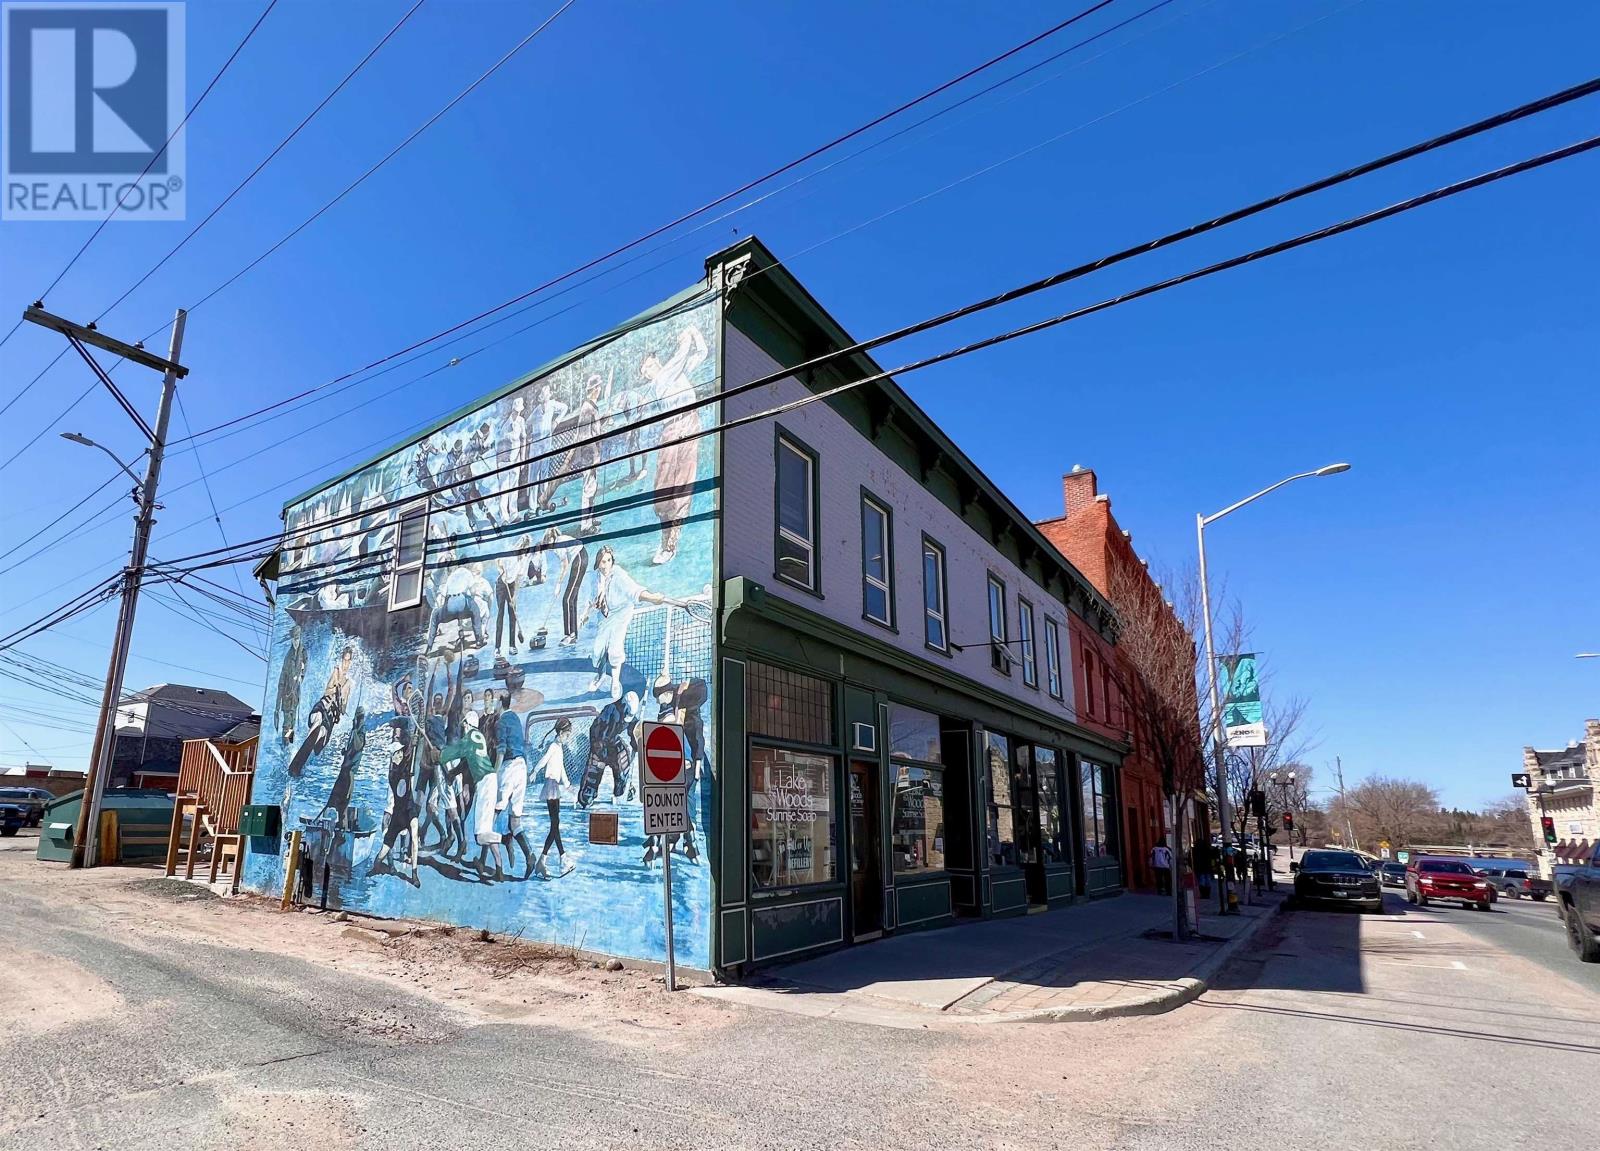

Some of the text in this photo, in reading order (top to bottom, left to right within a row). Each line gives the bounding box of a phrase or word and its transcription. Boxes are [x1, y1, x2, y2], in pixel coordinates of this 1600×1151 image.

[779, 763, 807, 790] Lake
[776, 787, 813, 808] Woods
[650, 812, 683, 827] ENTER
[797, 808, 817, 822] Soap
